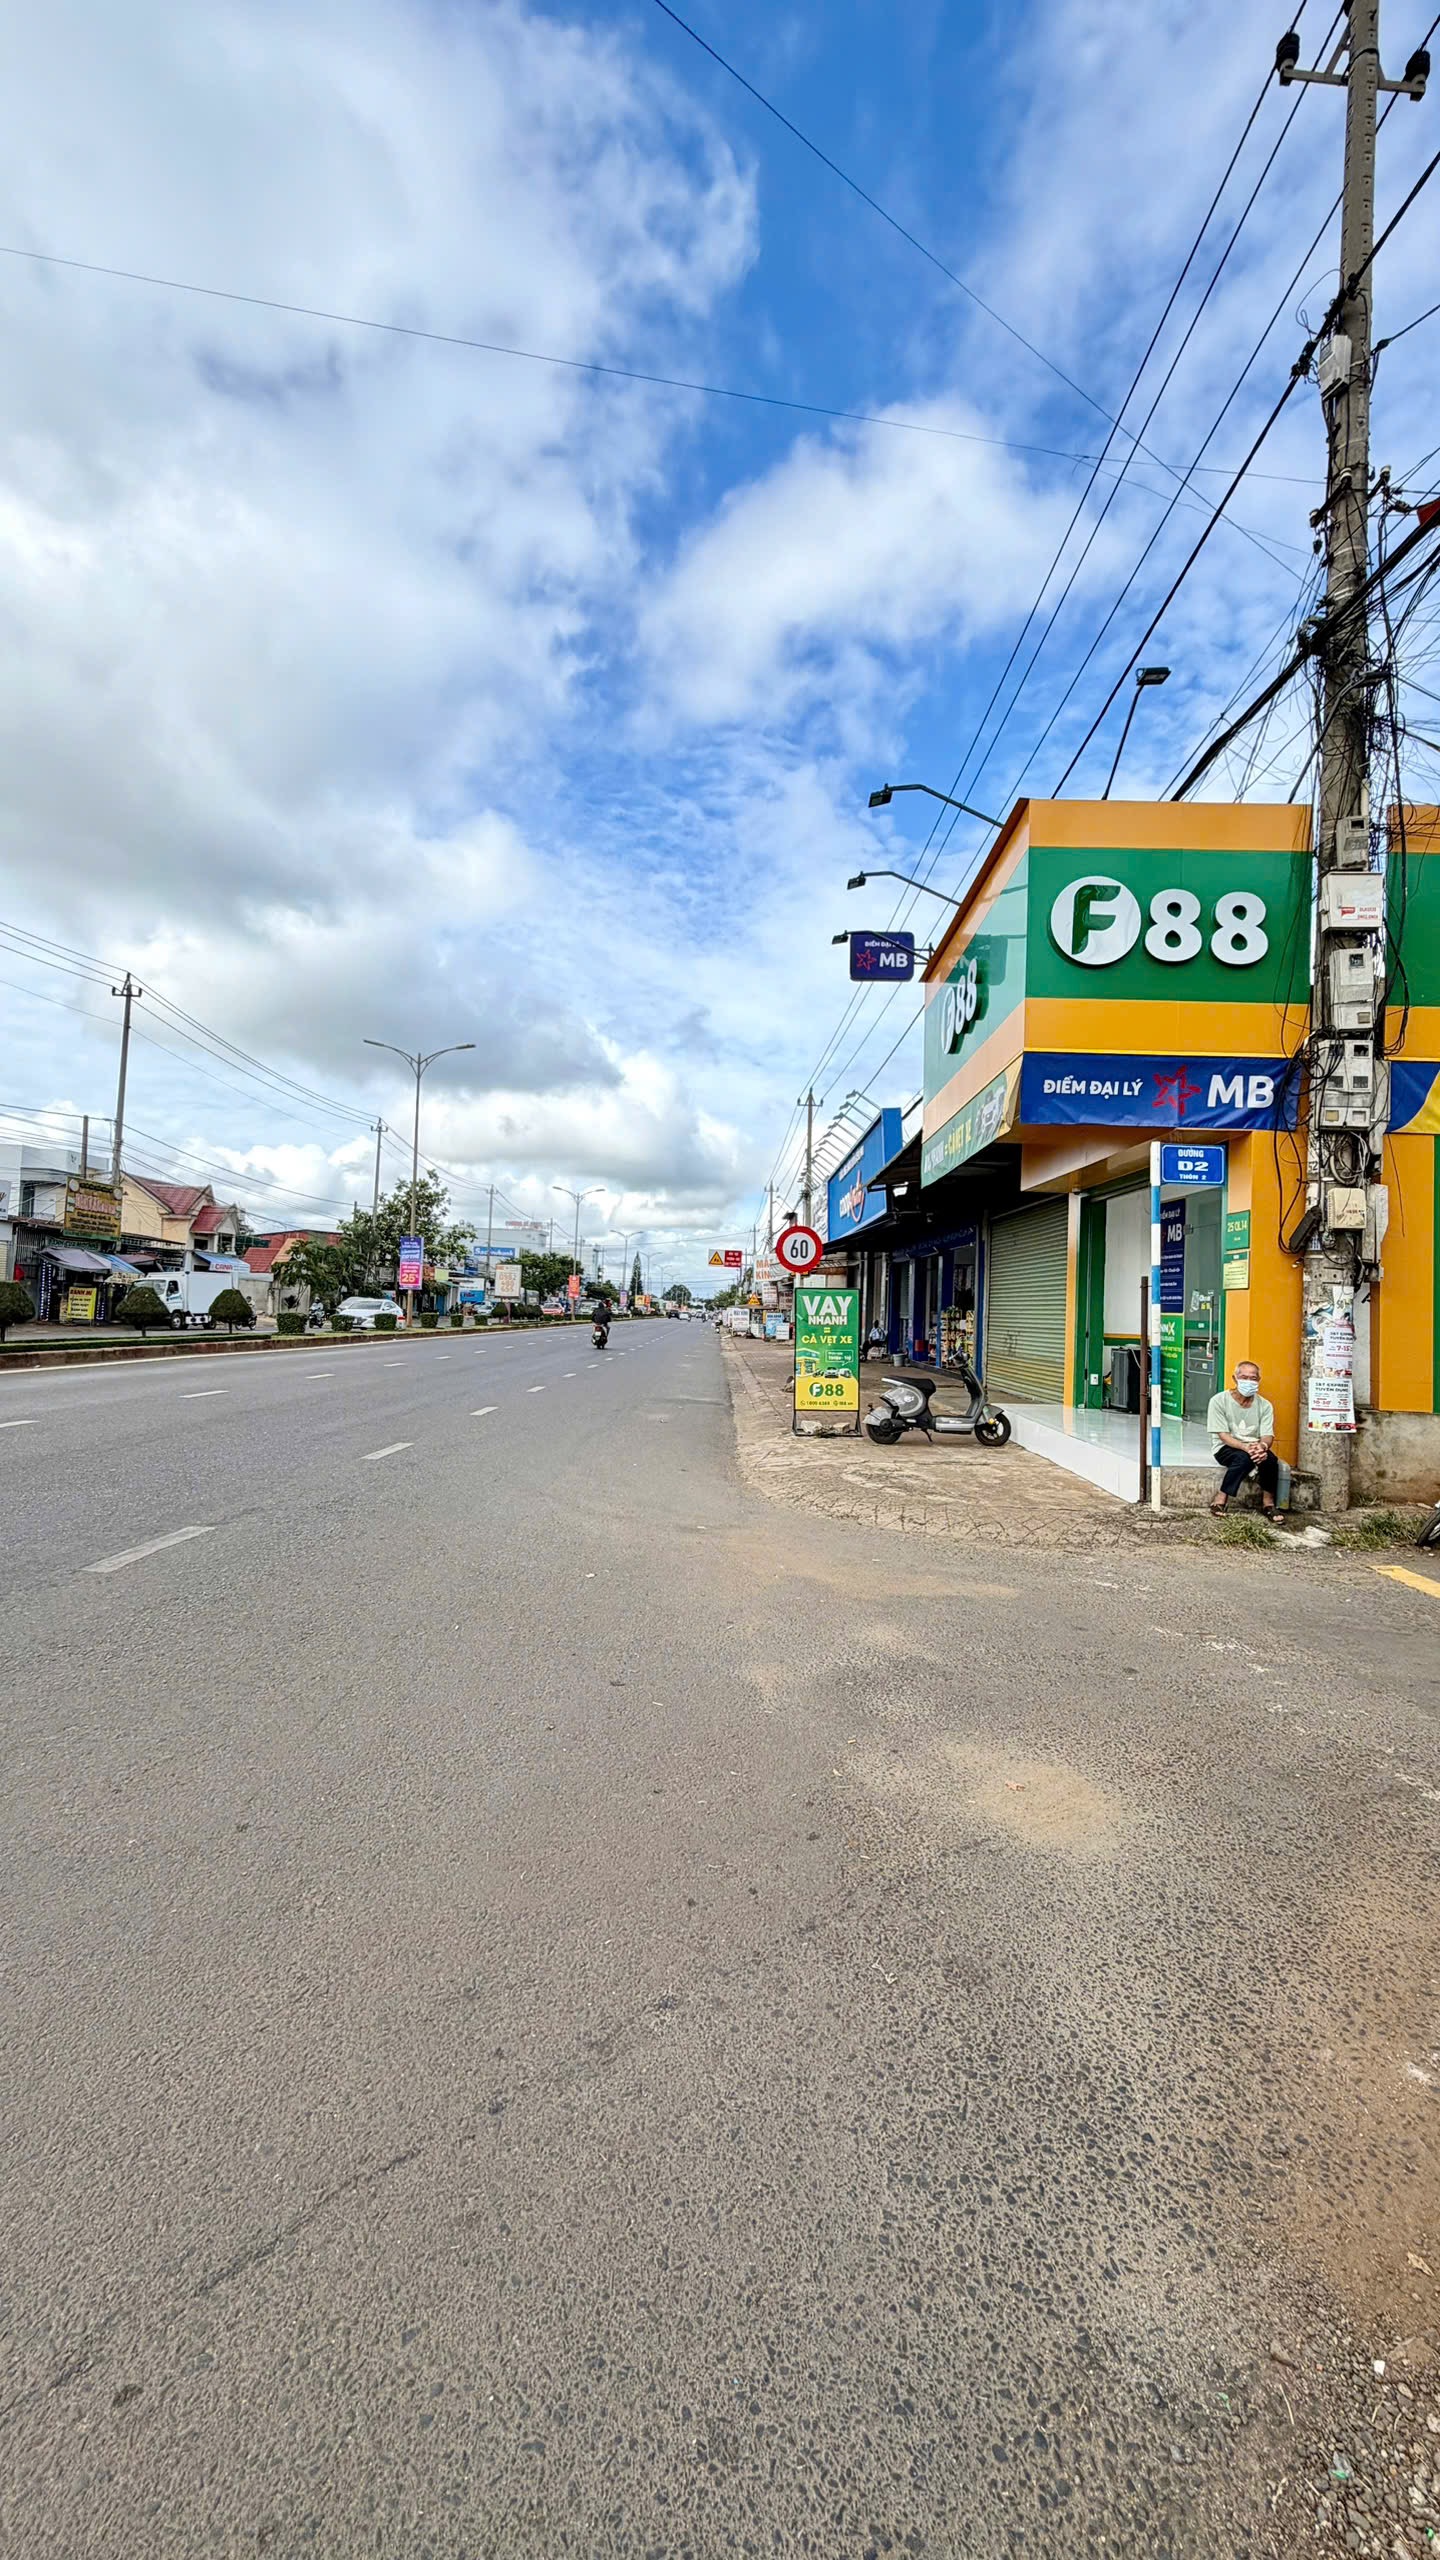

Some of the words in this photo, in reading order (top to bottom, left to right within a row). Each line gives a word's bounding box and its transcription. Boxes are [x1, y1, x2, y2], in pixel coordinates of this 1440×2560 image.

[1051, 876, 1269, 965] F88
[879, 952, 908, 968] MB
[1043, 1075, 1086, 1095] ĐIỂM
[1089, 1081, 1119, 1100] ĐẠI
[1122, 1078, 1144, 1097] LÝ
[1207, 1074, 1275, 1109] MB
[1178, 1161, 1209, 1171] D2
[1168, 1224, 1182, 1242] MB
[790, 1240, 808, 1259] 60
[802, 1296, 853, 1315] VAY
[808, 1315, 848, 1325] NHANH
[801, 1333, 817, 1344] CÀ
[820, 1335, 837, 1346] VẸT
[840, 1335, 853, 1344] XE
[809, 1382, 844, 1398] F88
